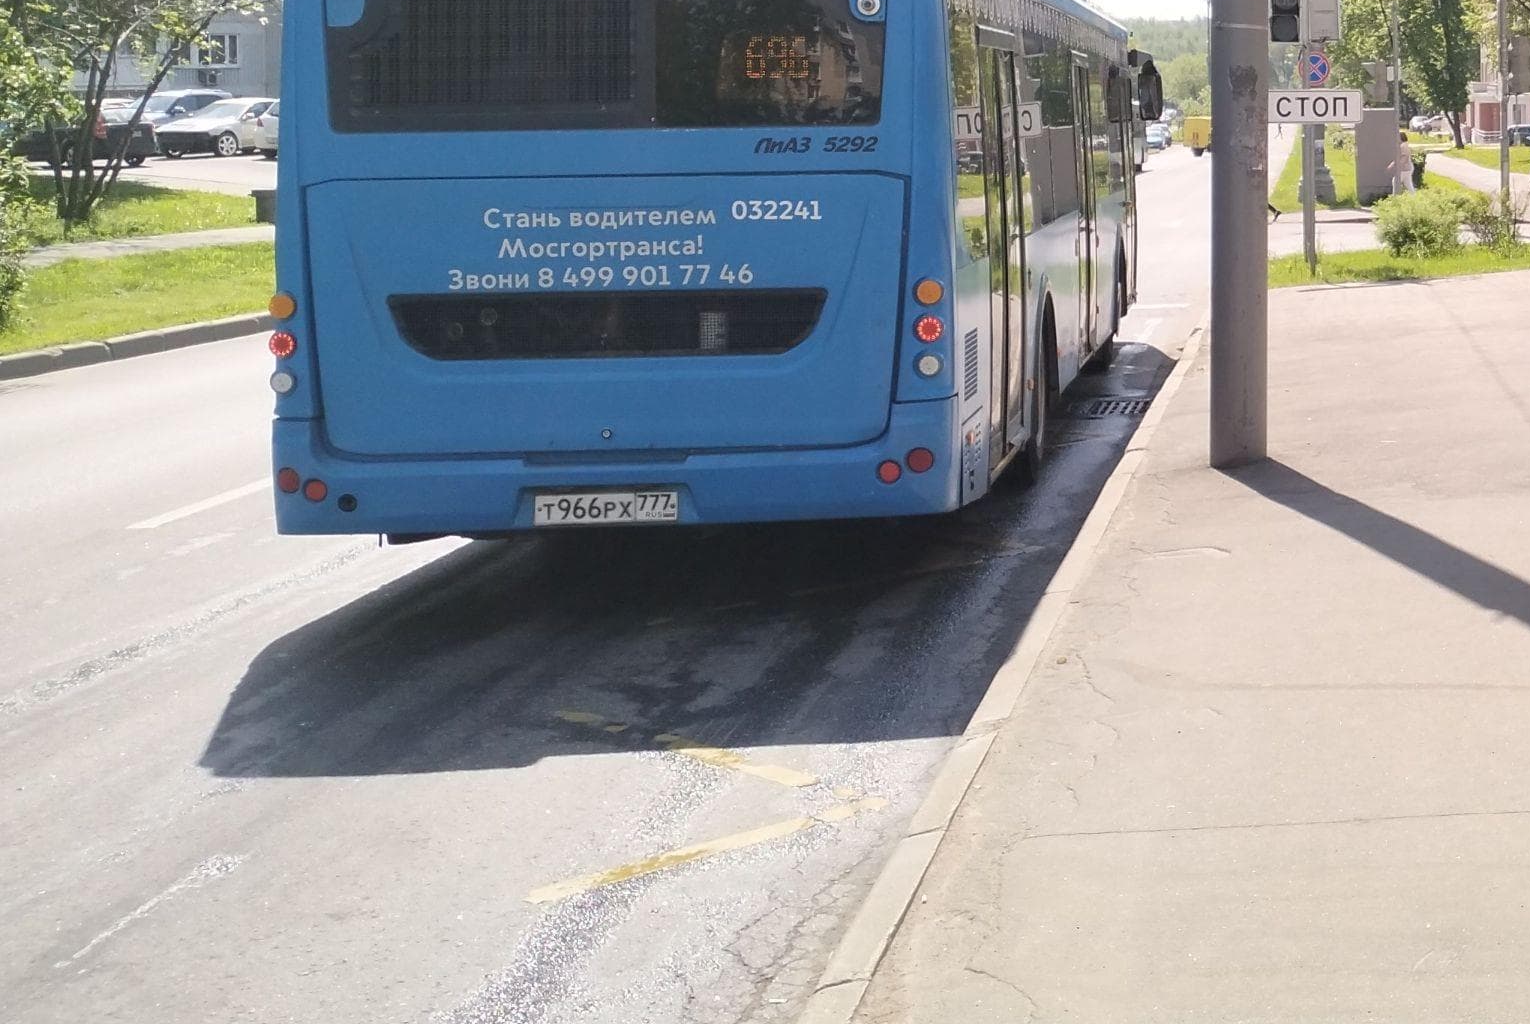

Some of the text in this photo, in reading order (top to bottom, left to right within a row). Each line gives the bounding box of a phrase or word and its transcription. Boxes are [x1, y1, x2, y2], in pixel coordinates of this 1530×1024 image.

[746, 35, 809, 78] 696
[1276, 96, 1348, 117] СТОП
[822, 136, 879, 153] 5292
[483, 208, 716, 230] Стань водителем
[731, 200, 822, 221] 032241
[499, 235, 704, 261] Мосгортранса!
[448, 264, 754, 290] Звони 8 499 901 77 46
[542, 494, 671, 520] Т966РХ 777
